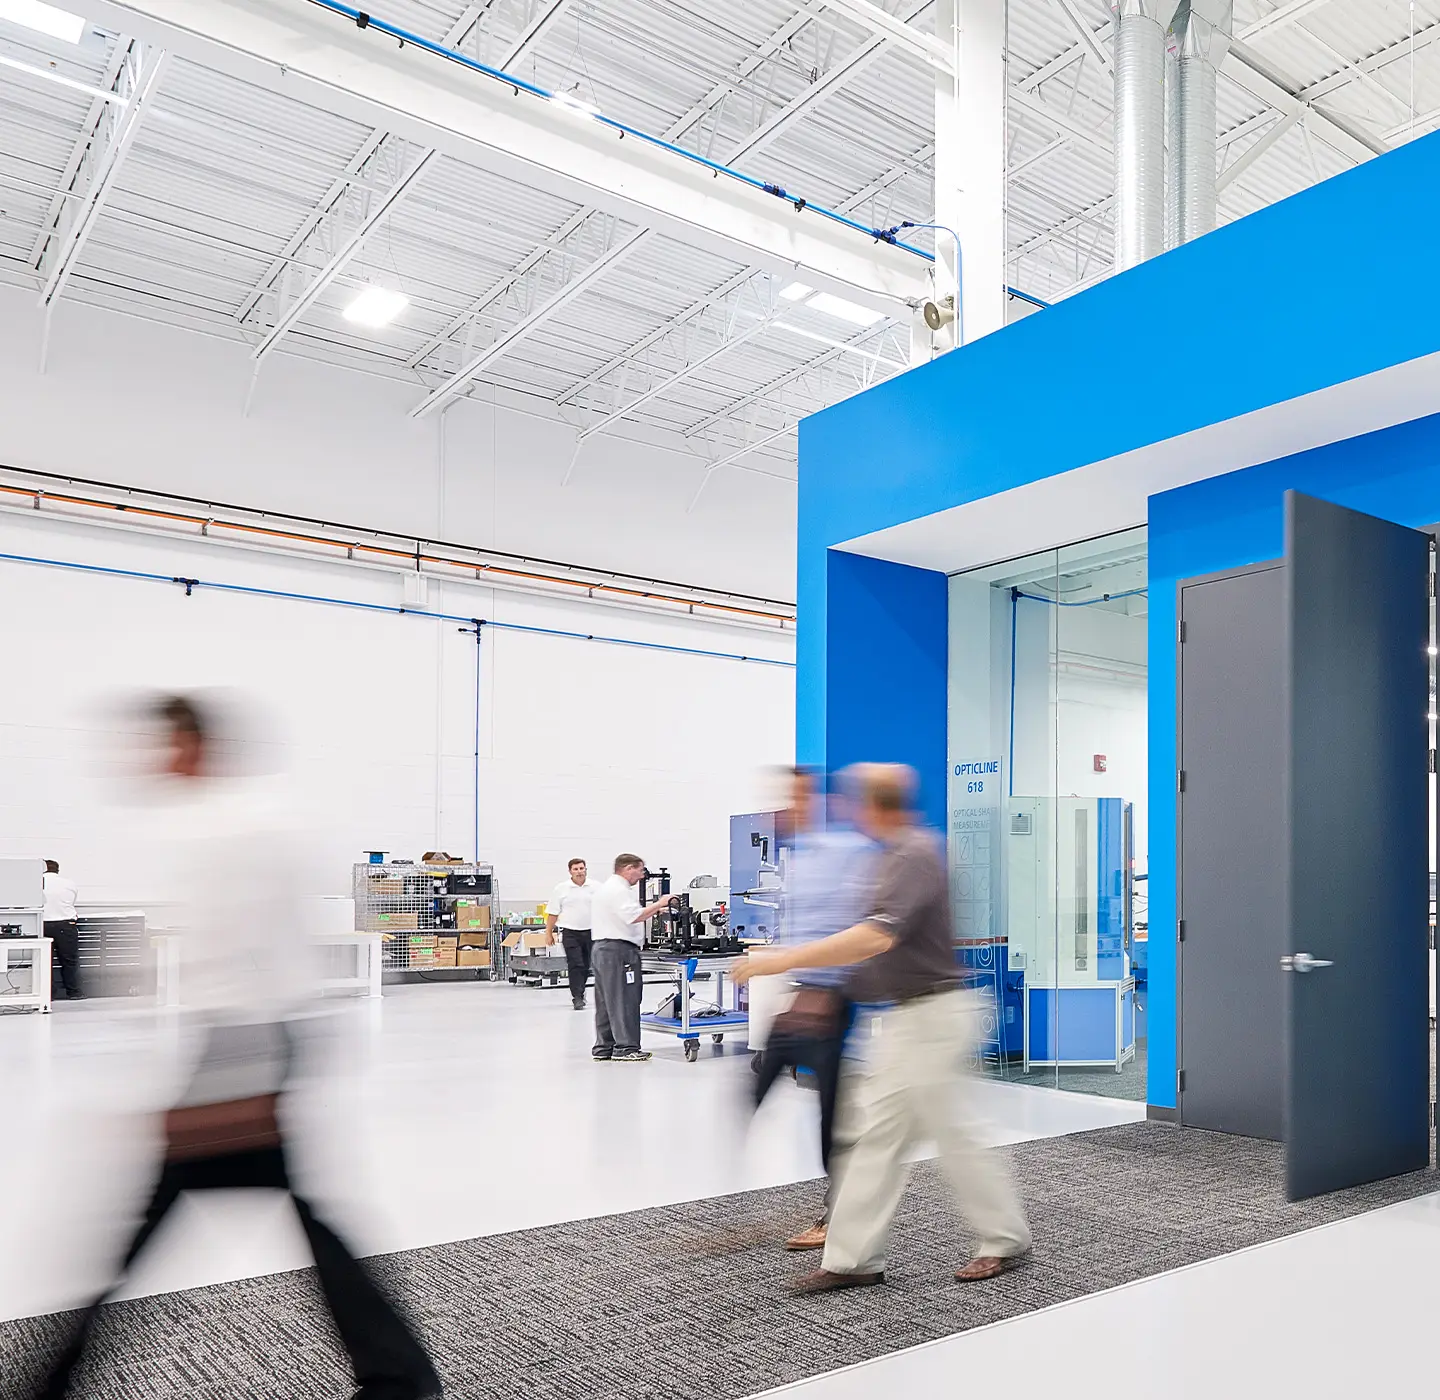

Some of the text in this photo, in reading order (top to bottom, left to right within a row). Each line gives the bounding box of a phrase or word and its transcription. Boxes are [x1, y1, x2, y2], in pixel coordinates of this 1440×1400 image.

[954, 761, 998, 776] OPTICLINE
[967, 781, 984, 793] 618
[953, 806, 997, 818] OPTICAL SHA
